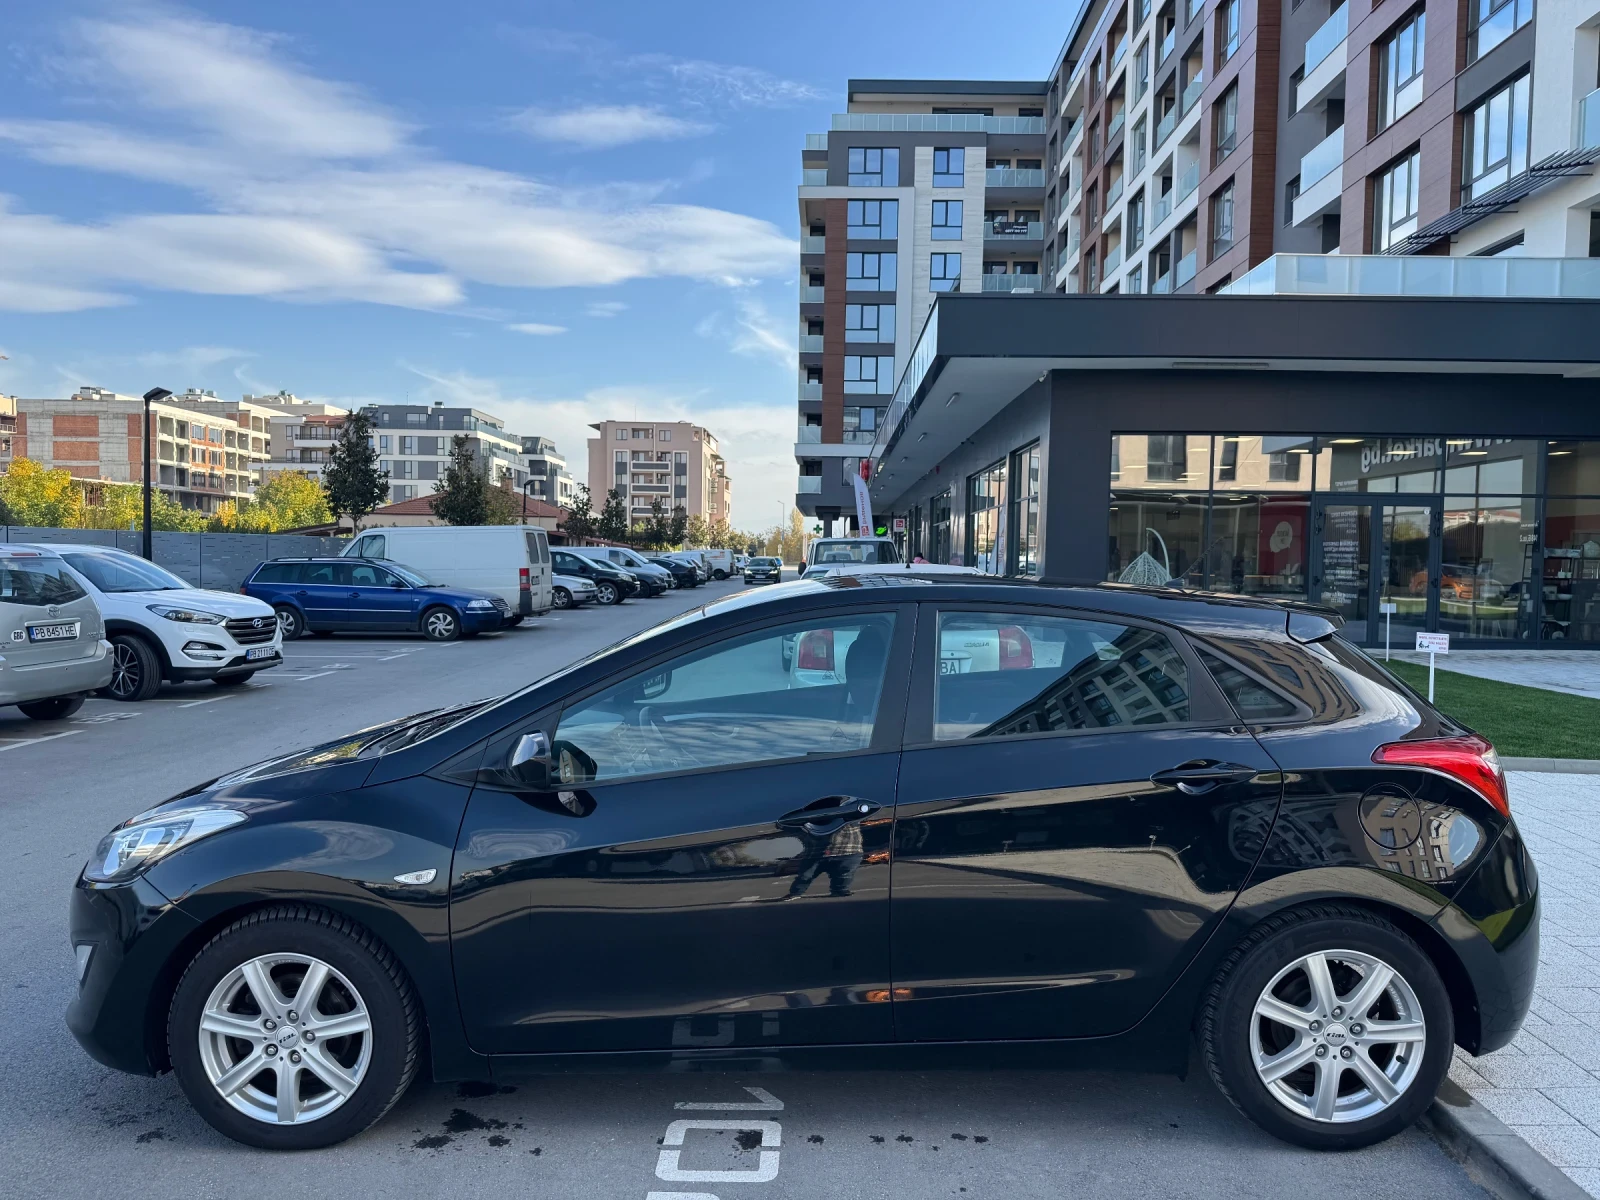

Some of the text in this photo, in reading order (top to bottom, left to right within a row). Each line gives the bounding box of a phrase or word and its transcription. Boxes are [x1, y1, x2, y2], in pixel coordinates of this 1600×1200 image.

[34, 627, 46, 638] PB
[46, 626, 65, 637] 8451
[65, 625, 76, 636] HE
[645, 1086, 785, 1200] 10
